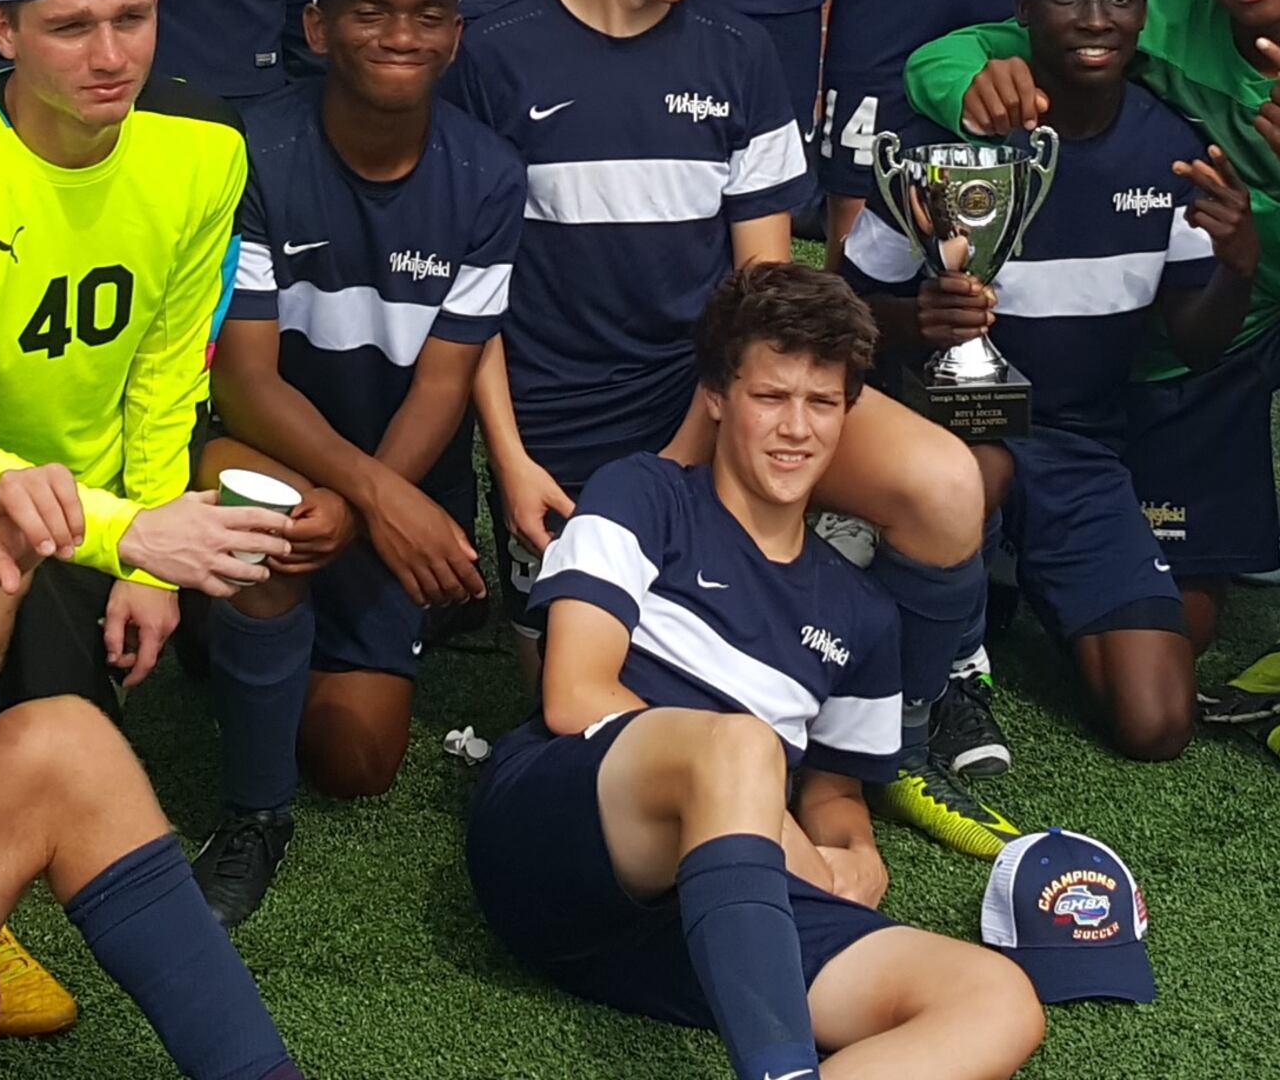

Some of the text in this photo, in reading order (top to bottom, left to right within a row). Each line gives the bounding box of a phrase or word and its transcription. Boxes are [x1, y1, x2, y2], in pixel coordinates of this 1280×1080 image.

[665, 93, 730, 122] Whitefield
[1113, 187, 1172, 217] Whitefield
[389, 250, 451, 281] Whitefield
[18, 264, 134, 359] 40
[1039, 870, 1116, 911] CHAMPIONS
[1059, 895, 1110, 912] GHSA
[1073, 922, 1119, 940] SOCCER
